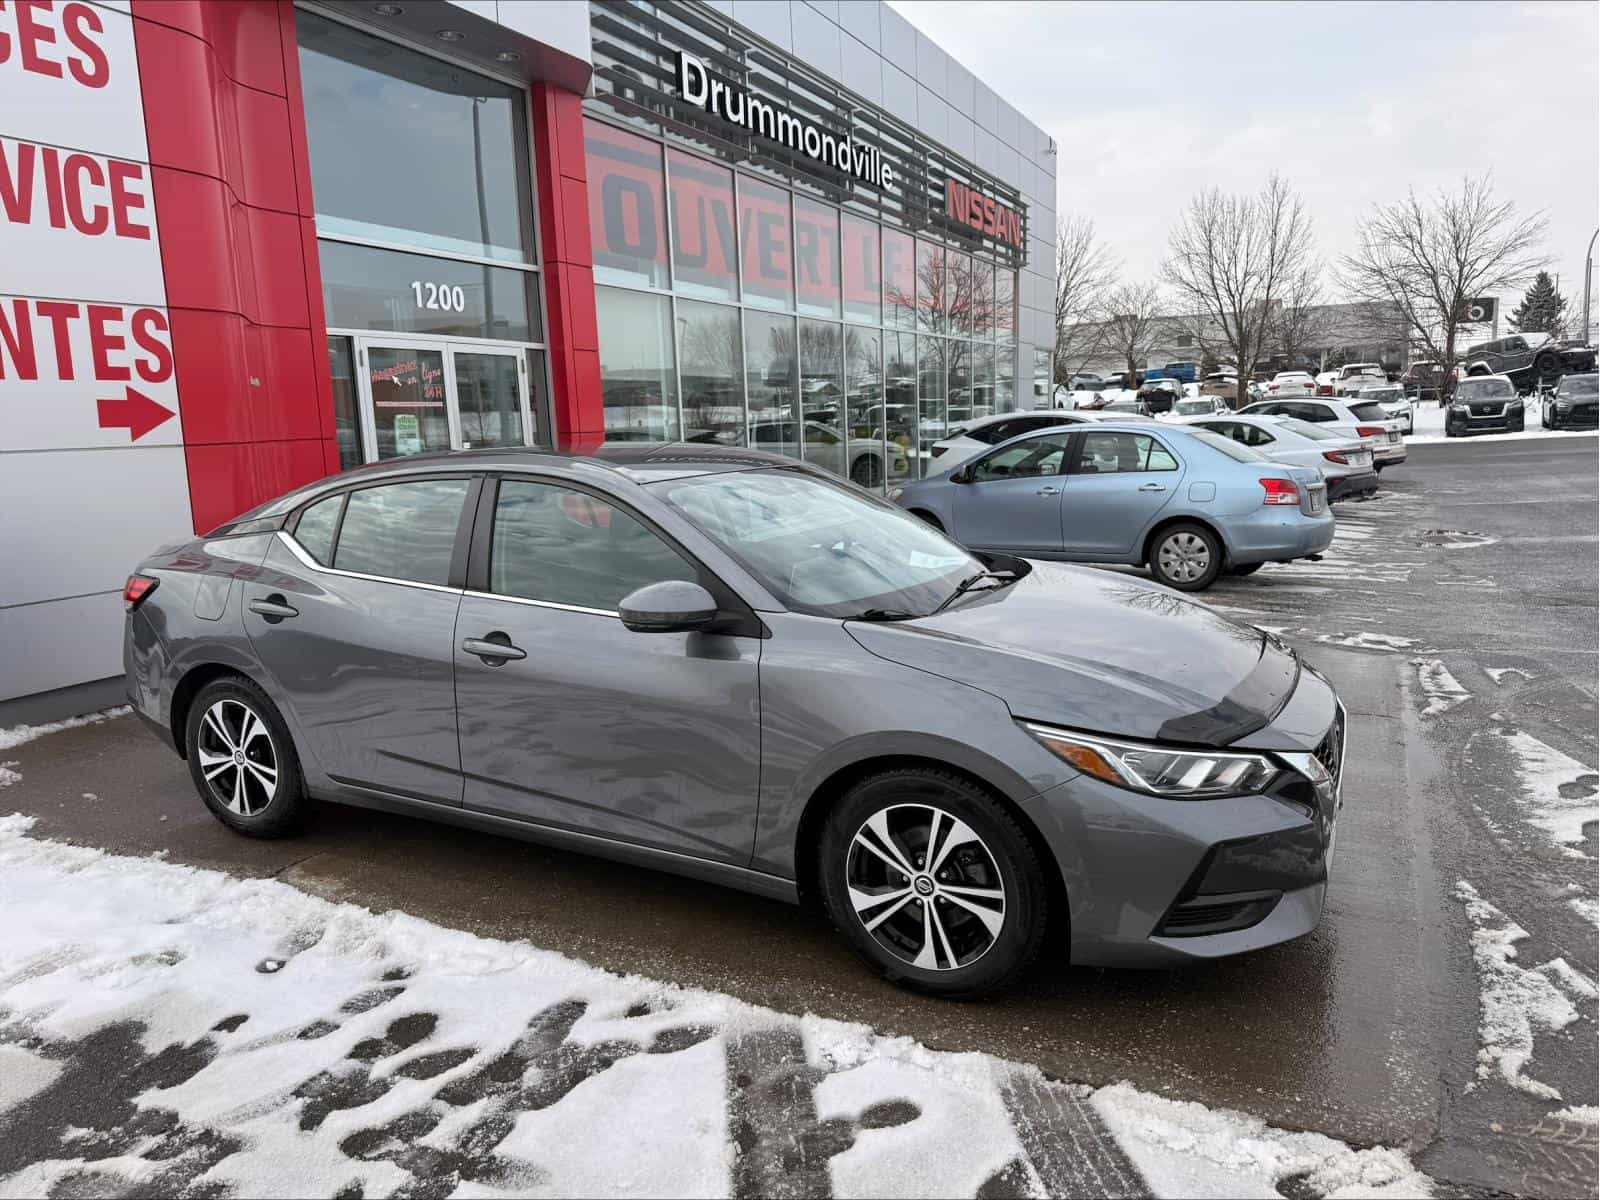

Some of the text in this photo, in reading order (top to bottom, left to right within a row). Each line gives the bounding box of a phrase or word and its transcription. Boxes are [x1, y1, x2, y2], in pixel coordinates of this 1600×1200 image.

[0, 0, 110, 89] ES
[680, 51, 893, 190] Drummondville
[602, 172, 840, 288] OUVERT
[946, 178, 1020, 248] NISSAN
[411, 281, 465, 312] 1200
